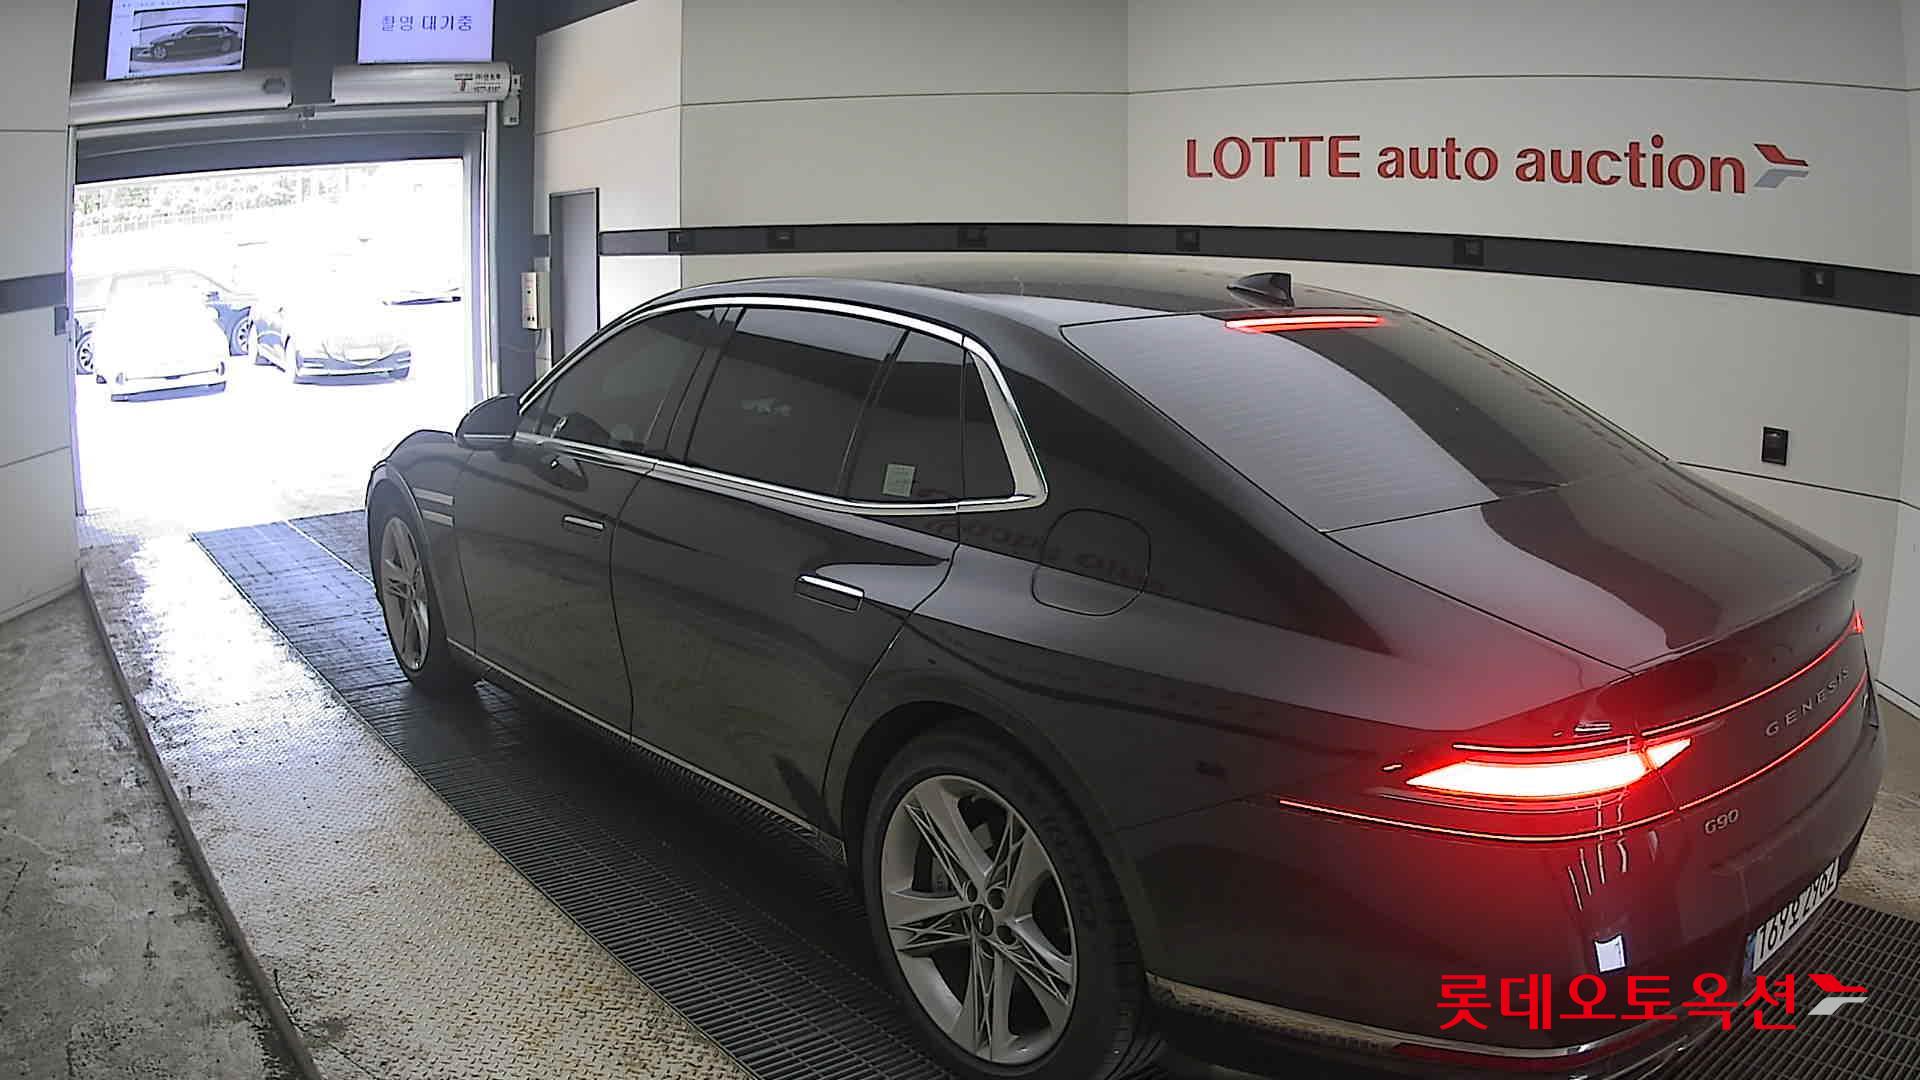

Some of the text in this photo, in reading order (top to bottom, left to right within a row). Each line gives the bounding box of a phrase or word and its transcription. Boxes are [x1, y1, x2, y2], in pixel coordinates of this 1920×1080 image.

[422, 15, 473, 32] 대기중
[1186, 134, 1746, 194] LOTTE auto auction
[1765, 669, 1849, 737] GENESIS
[1704, 808, 1739, 835] G90
